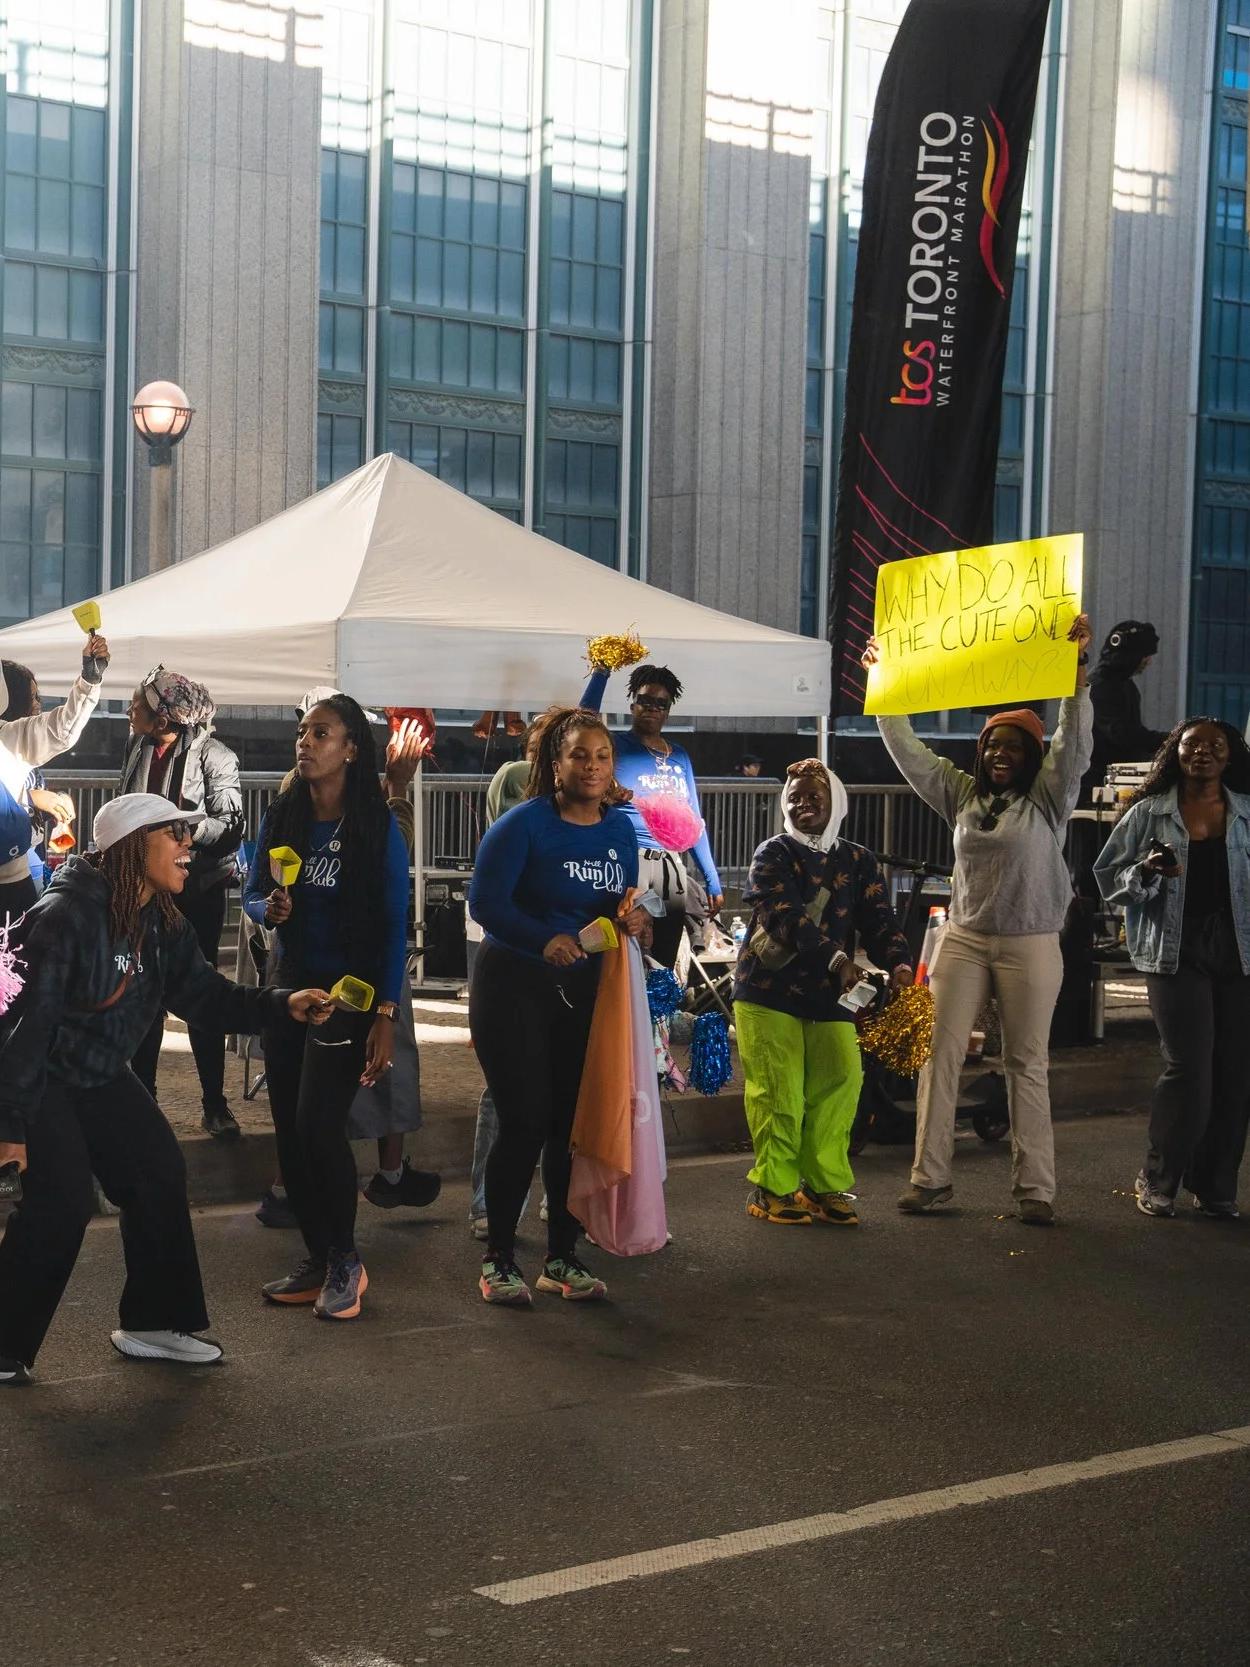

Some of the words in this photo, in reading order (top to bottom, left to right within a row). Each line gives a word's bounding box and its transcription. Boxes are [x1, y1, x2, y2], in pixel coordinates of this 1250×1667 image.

[905, 111, 957, 329] TORONTO
[936, 255, 961, 407] WATERFRONT
[951, 115, 975, 242] MARATHON
[882, 567, 952, 624] WHY
[958, 559, 1014, 611] DO
[1021, 555, 1077, 600] ALL
[877, 621, 934, 658] THE
[940, 605, 1008, 651] CUTE
[883, 664, 947, 707] RUN
[563, 861, 604, 883] Run
